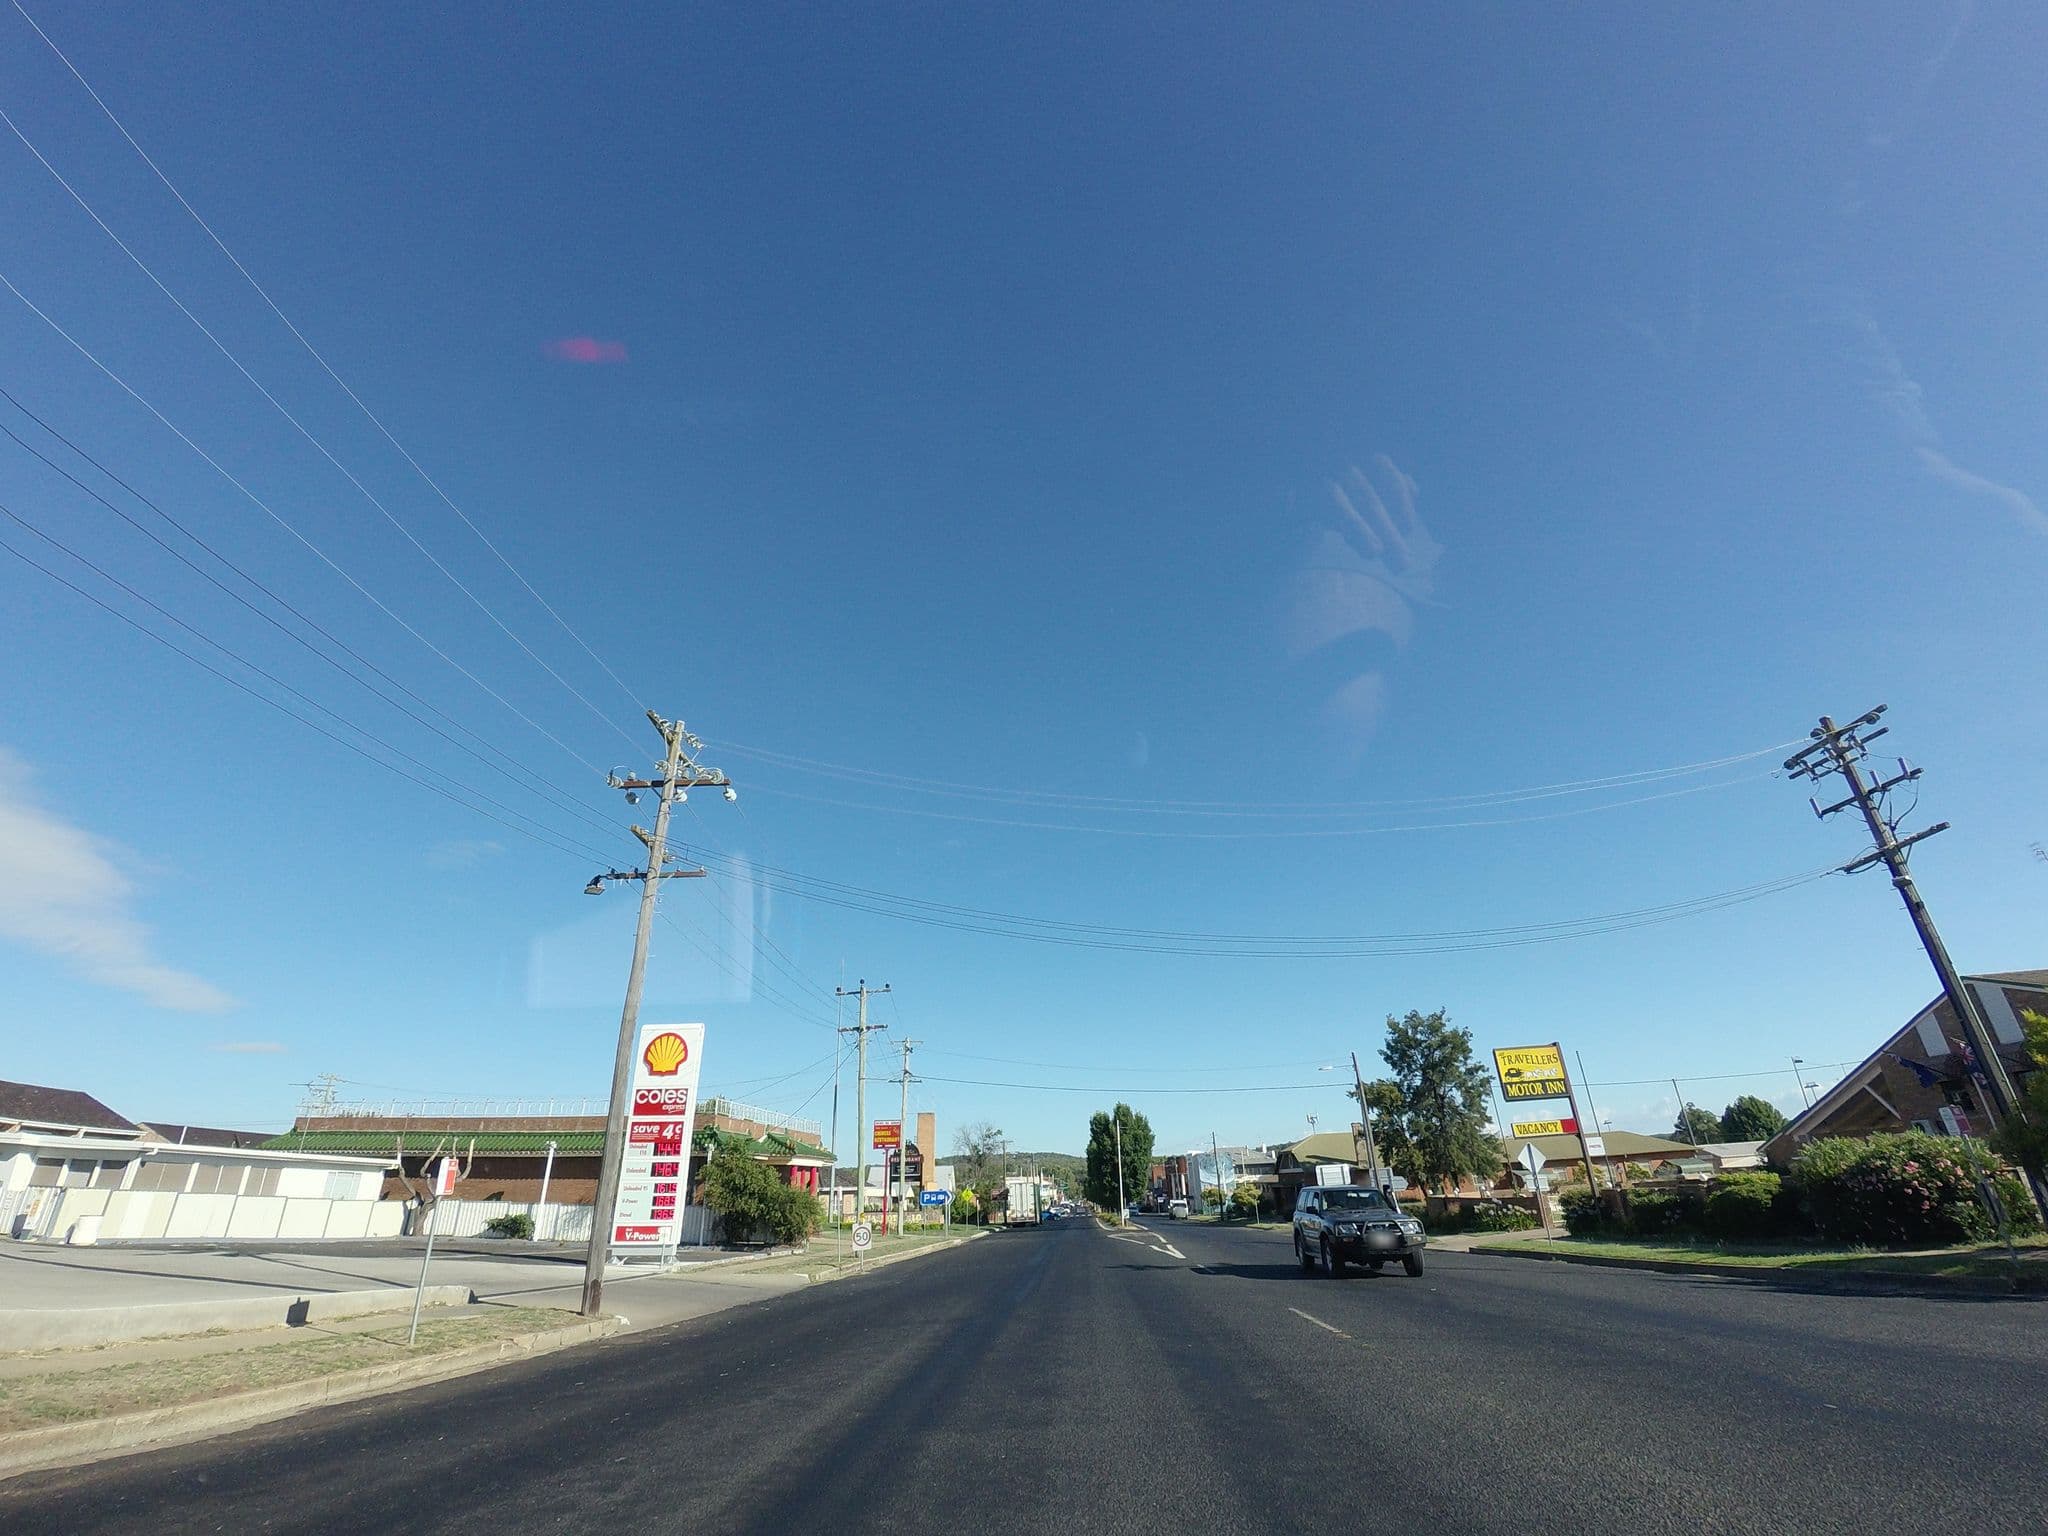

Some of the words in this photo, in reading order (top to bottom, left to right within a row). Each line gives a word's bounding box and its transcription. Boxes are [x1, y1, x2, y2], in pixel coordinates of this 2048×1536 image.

[1501, 1053, 1559, 1066] TRAVELLERS
[1506, 1082, 1545, 1097] MOTOR
[1546, 1081, 1567, 1094] INN
[636, 1088, 687, 1104] coles
[632, 1124, 660, 1134] save
[1515, 1121, 1559, 1135] VACANCY
[924, 1193, 930, 1202] P
[625, 1231, 661, 1241] V-Power
[855, 1231, 868, 1241] 50
